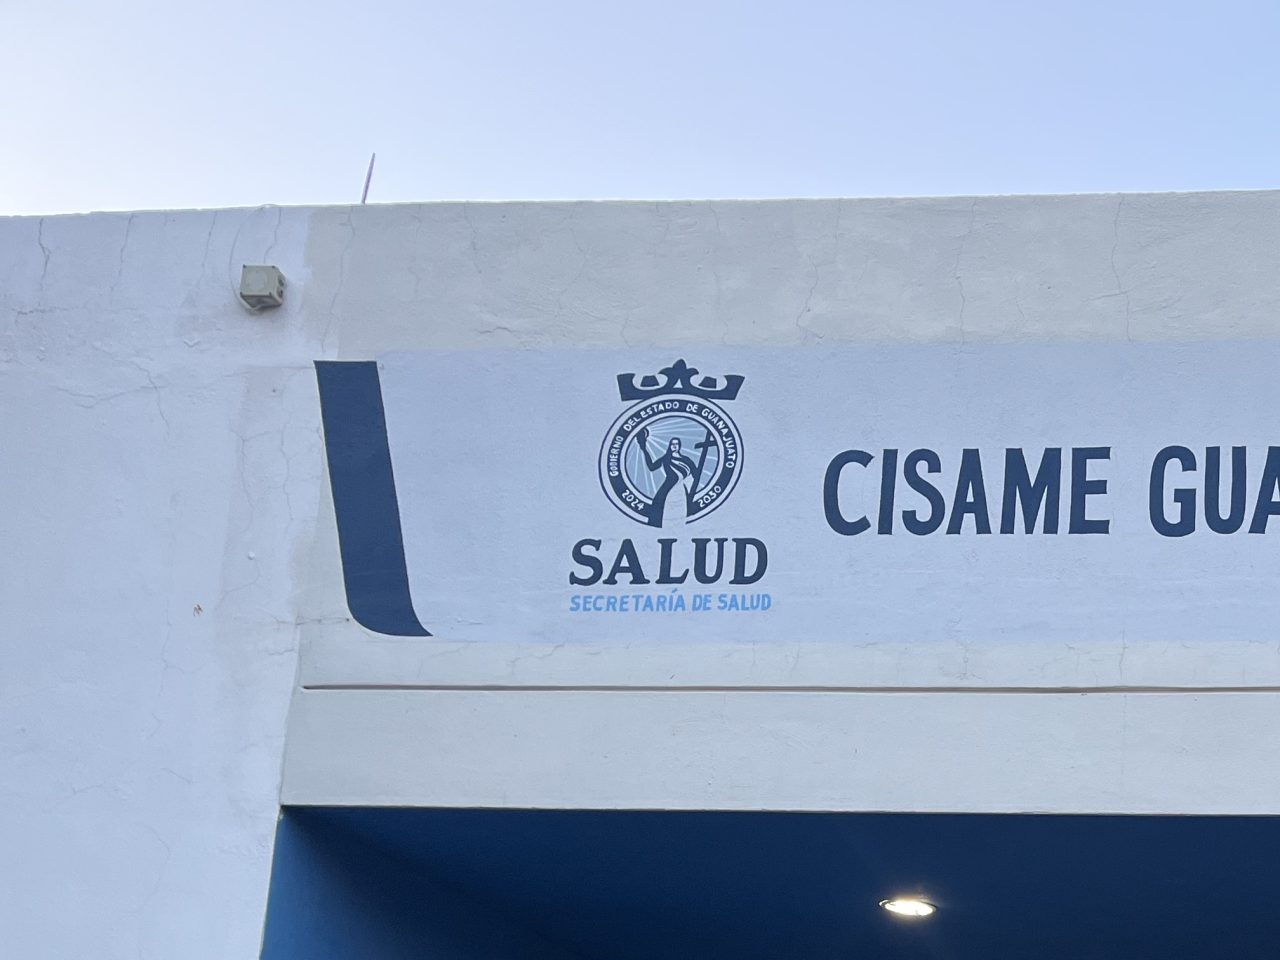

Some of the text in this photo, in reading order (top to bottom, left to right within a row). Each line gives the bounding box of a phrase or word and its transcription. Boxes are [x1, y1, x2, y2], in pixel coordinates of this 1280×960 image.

[623, 416, 642, 432] DEL
[640, 401, 680, 418] ESTADO
[685, 403, 699, 413] DE
[701, 407, 737, 469] GUANAJUATO
[621, 489, 645, 512] 2024
[698, 485, 722, 508] 2030
[823, 446, 1112, 536] CISAME
[569, 538, 768, 586] SALUD
[569, 588, 772, 612] SECRETARÍA DE SALUD
